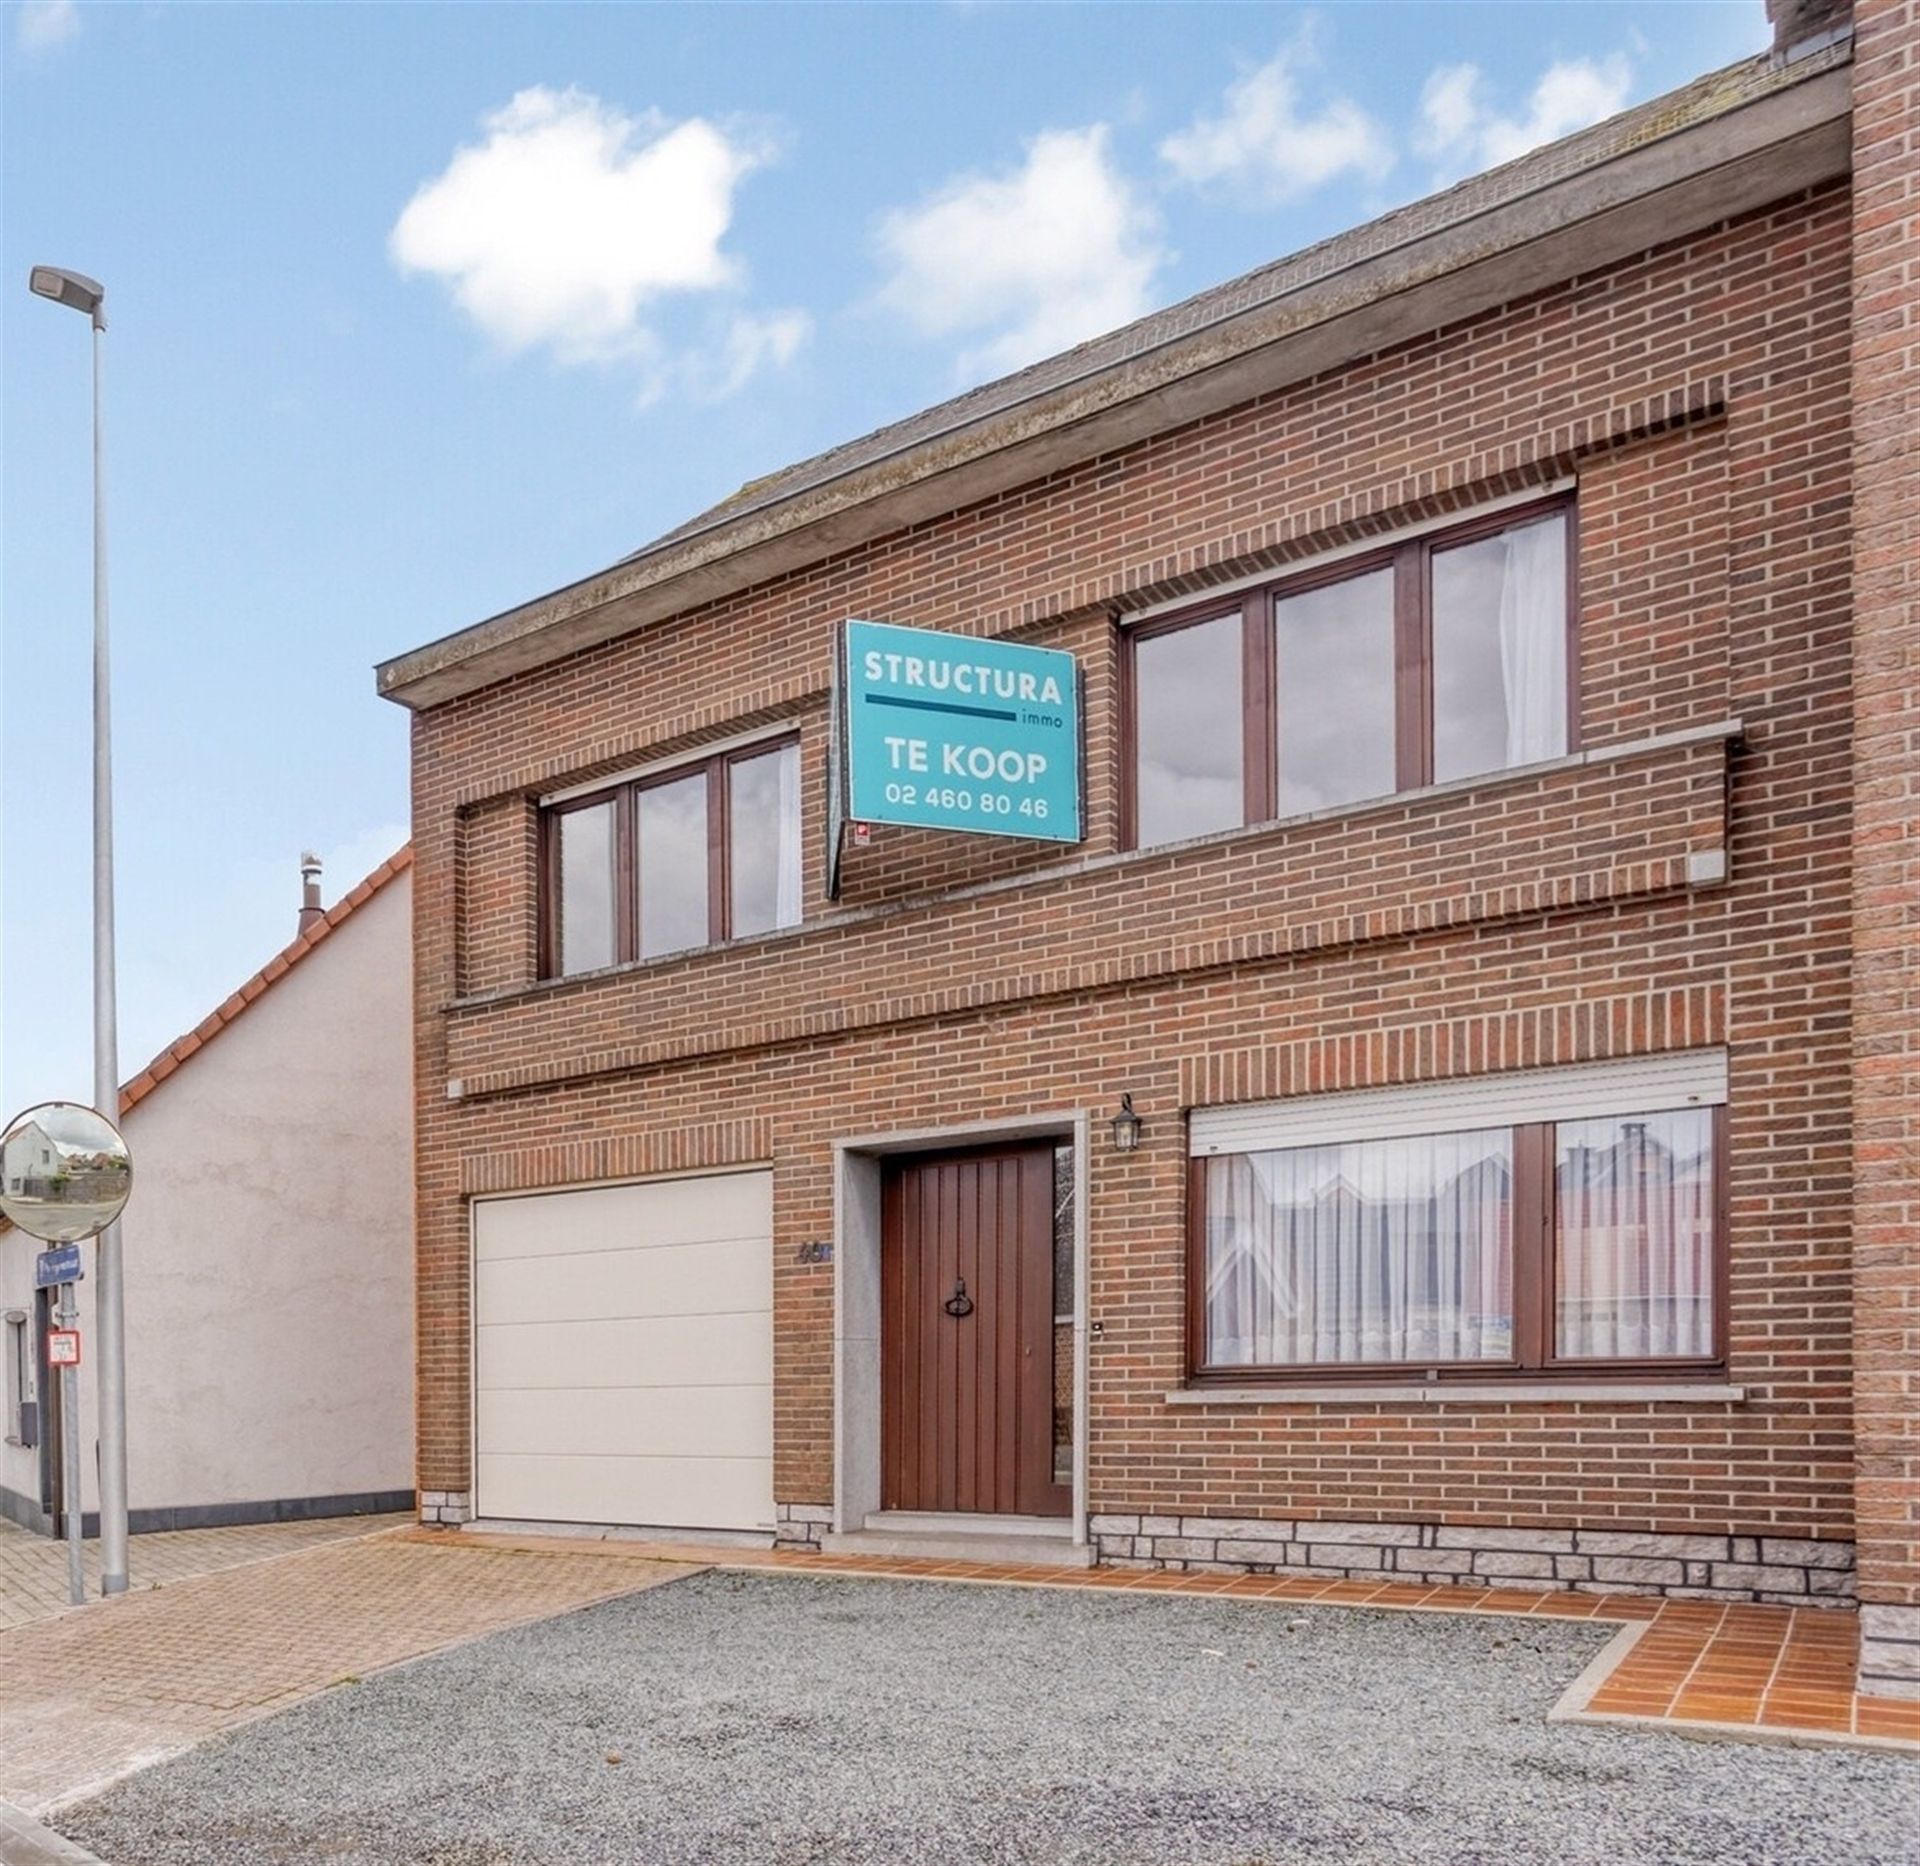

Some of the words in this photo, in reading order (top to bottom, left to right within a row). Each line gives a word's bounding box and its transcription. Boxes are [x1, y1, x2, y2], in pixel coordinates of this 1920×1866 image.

[864, 651, 1063, 705] STRUCTURA
[1021, 708, 1063, 729] immo
[884, 736, 928, 773] TE
[942, 743, 1047, 784] KOOP
[885, 783, 916, 805] 02
[925, 788, 972, 810] 460
[980, 793, 1011, 814] 80
[1019, 798, 1048, 818] 46
